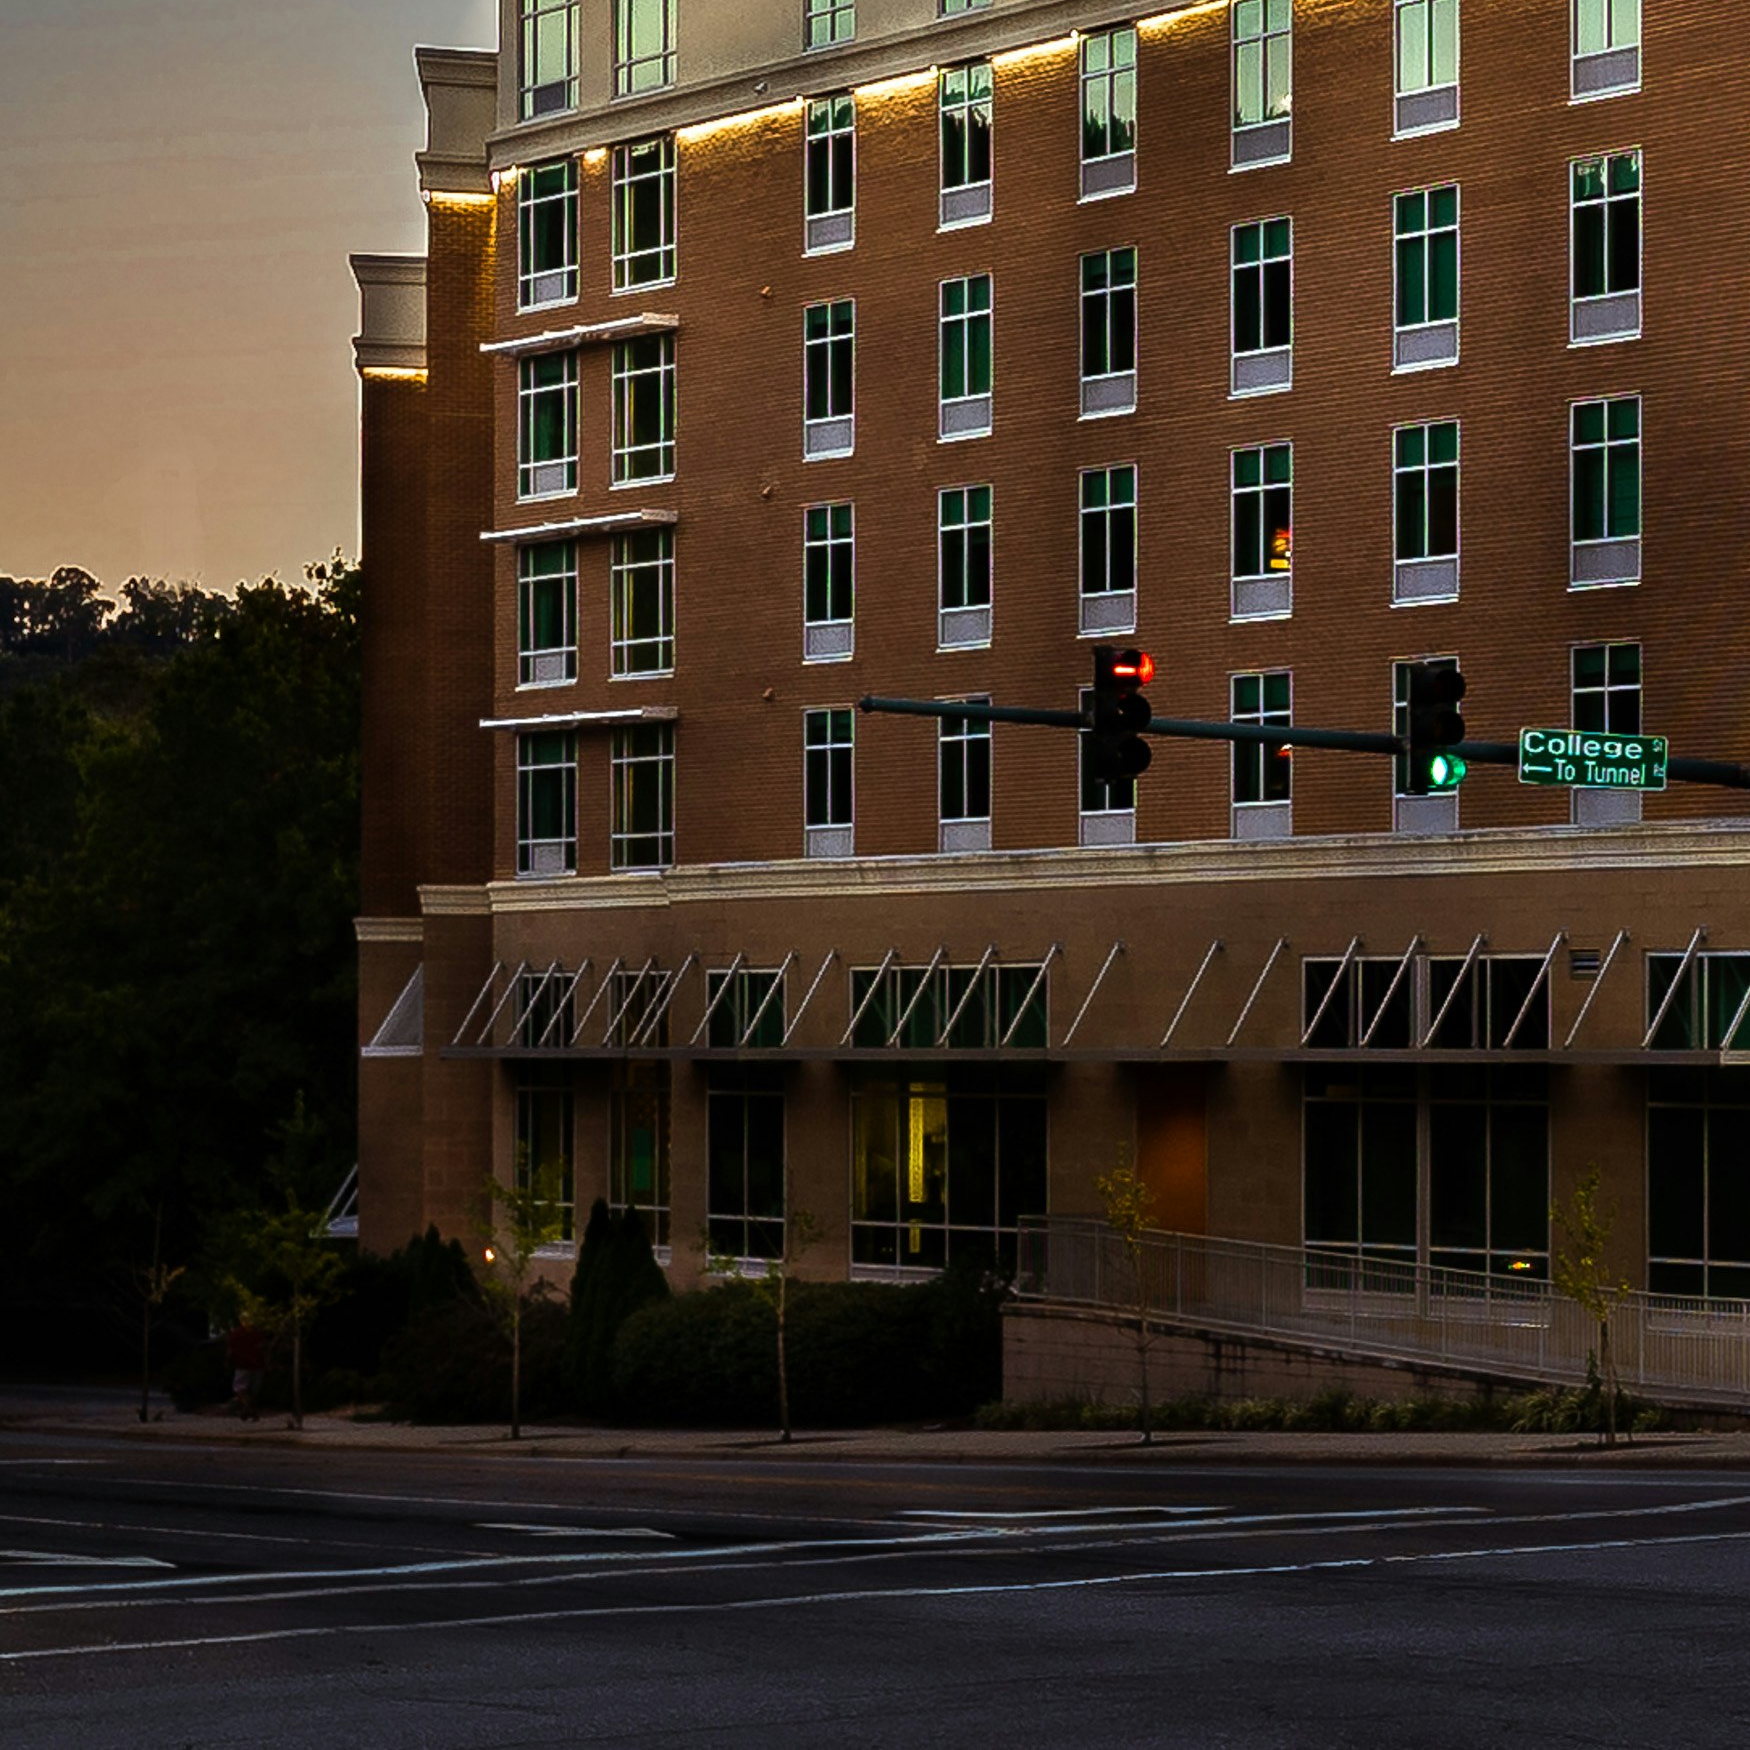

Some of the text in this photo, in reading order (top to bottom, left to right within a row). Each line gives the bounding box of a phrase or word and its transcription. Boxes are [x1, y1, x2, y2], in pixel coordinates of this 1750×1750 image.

[1524, 732, 1643, 759] College
[1554, 759, 1576, 781] To
[1585, 761, 1646, 785] Tunnel
